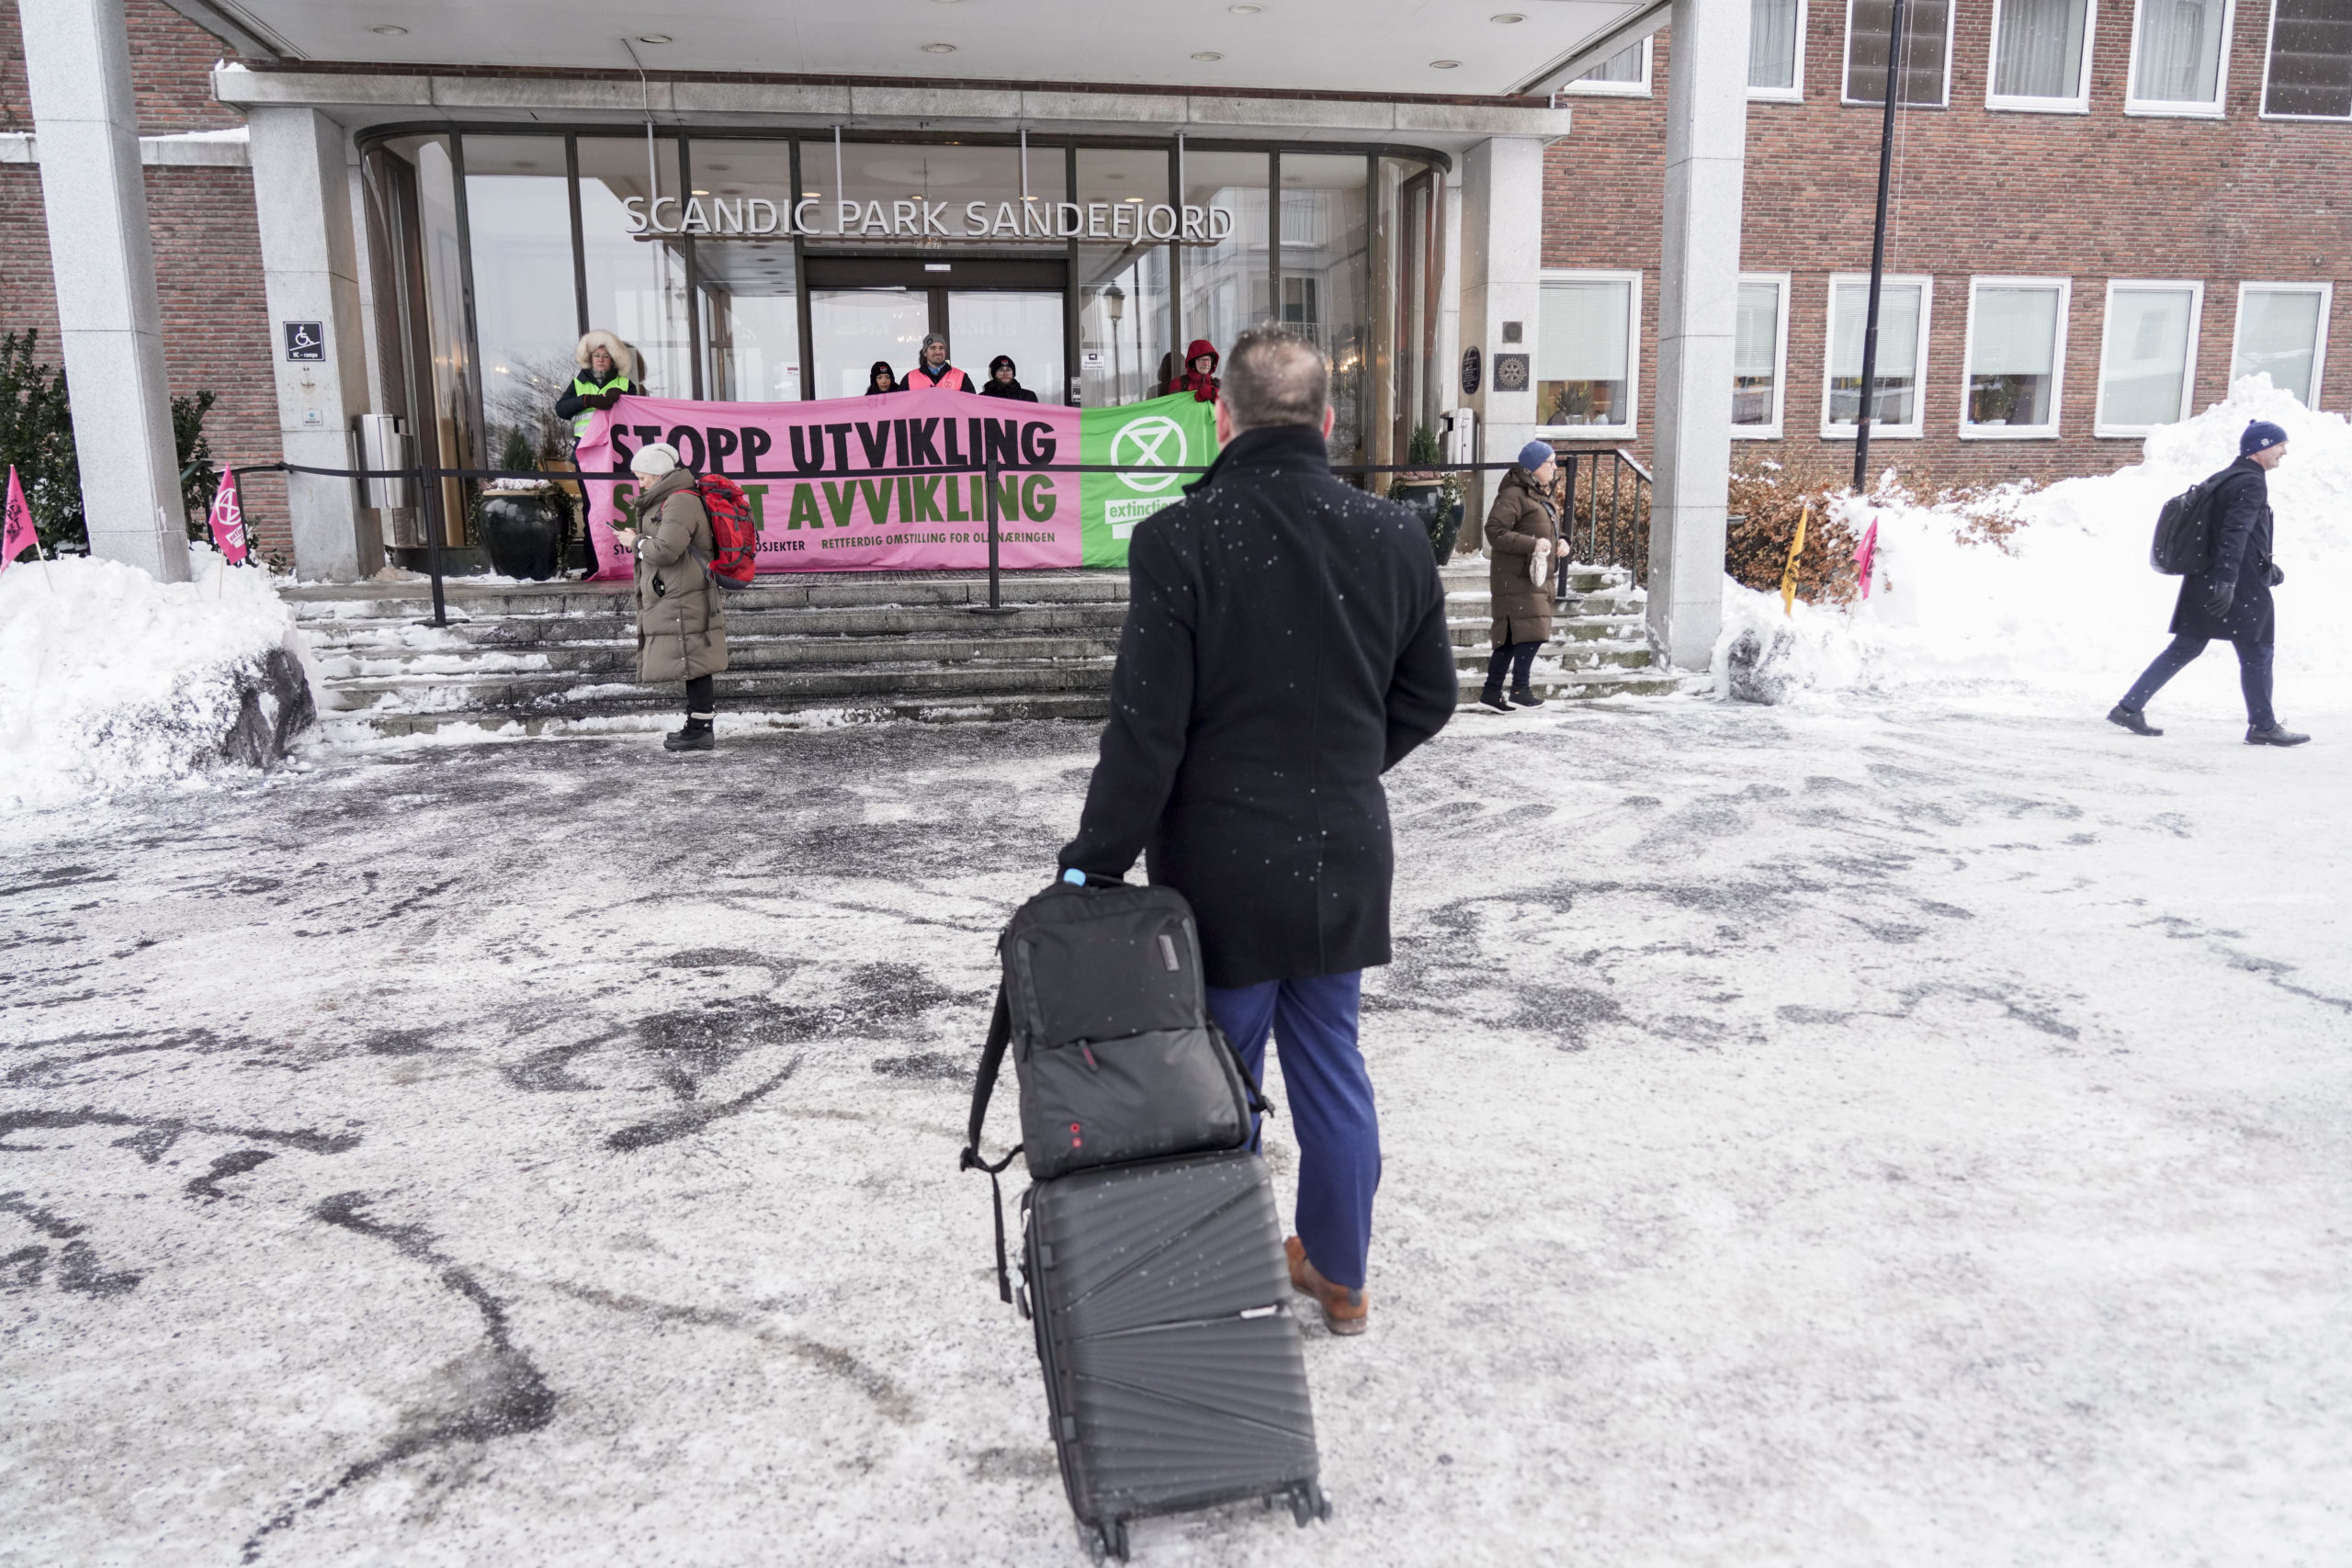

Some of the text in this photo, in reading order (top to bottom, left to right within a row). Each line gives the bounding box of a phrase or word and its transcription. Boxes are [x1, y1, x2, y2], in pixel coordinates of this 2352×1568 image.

[623, 196, 1237, 246] SCANDIC PARK SANDEFJORD
[788, 417, 1057, 472] UTVIKLING
[787, 474, 1057, 530] AVVIKLING
[755, 540, 806, 552] OSJEKTER
[821, 535, 883, 549] RETTFERDIG
[886, 533, 946, 545] OMSTILLING
[950, 533, 970, 544] FOR
